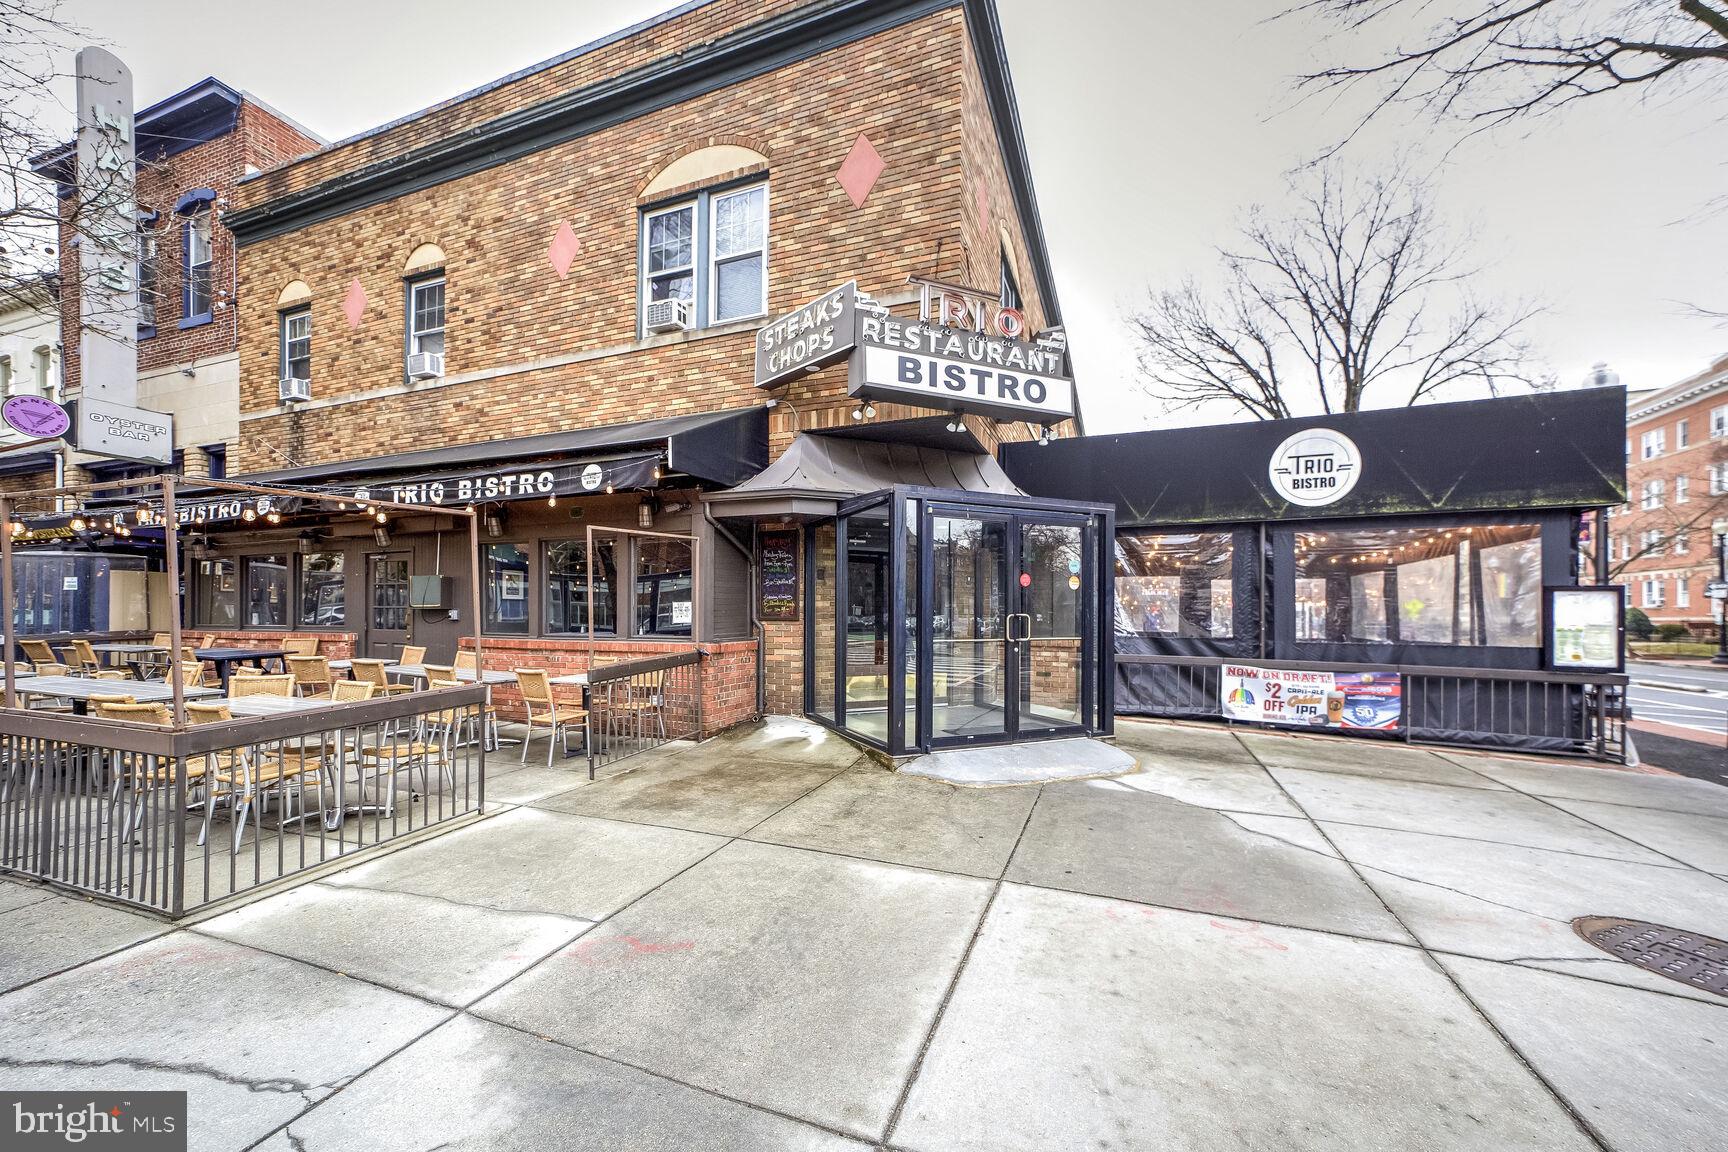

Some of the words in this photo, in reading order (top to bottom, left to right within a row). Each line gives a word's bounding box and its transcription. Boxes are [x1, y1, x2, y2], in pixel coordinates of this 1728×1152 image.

[905, 274, 1024, 337] TRIO
[763, 291, 844, 351] STEAKS
[769, 325, 834, 373] CHOPS
[863, 317, 1060, 375] RESTAURANT
[898, 355, 1047, 404] BISTRO
[90, 412, 167, 434] OYSTER
[108, 427, 150, 441] BAR
[1287, 453, 1334, 475] TRIO
[391, 482, 444, 504] TRIO
[458, 471, 555, 500] BISTRO
[1292, 476, 1336, 490] BISTRO
[179, 500, 241, 523] BISTRO
[1226, 666, 1260, 679] NOW
[1262, 671, 1280, 680] ON
[1283, 672, 1333, 683] DRAFT!
[1265, 682, 1282, 699] $2
[1264, 700, 1285, 712] OFF
[1296, 705, 1317, 715] IPA
